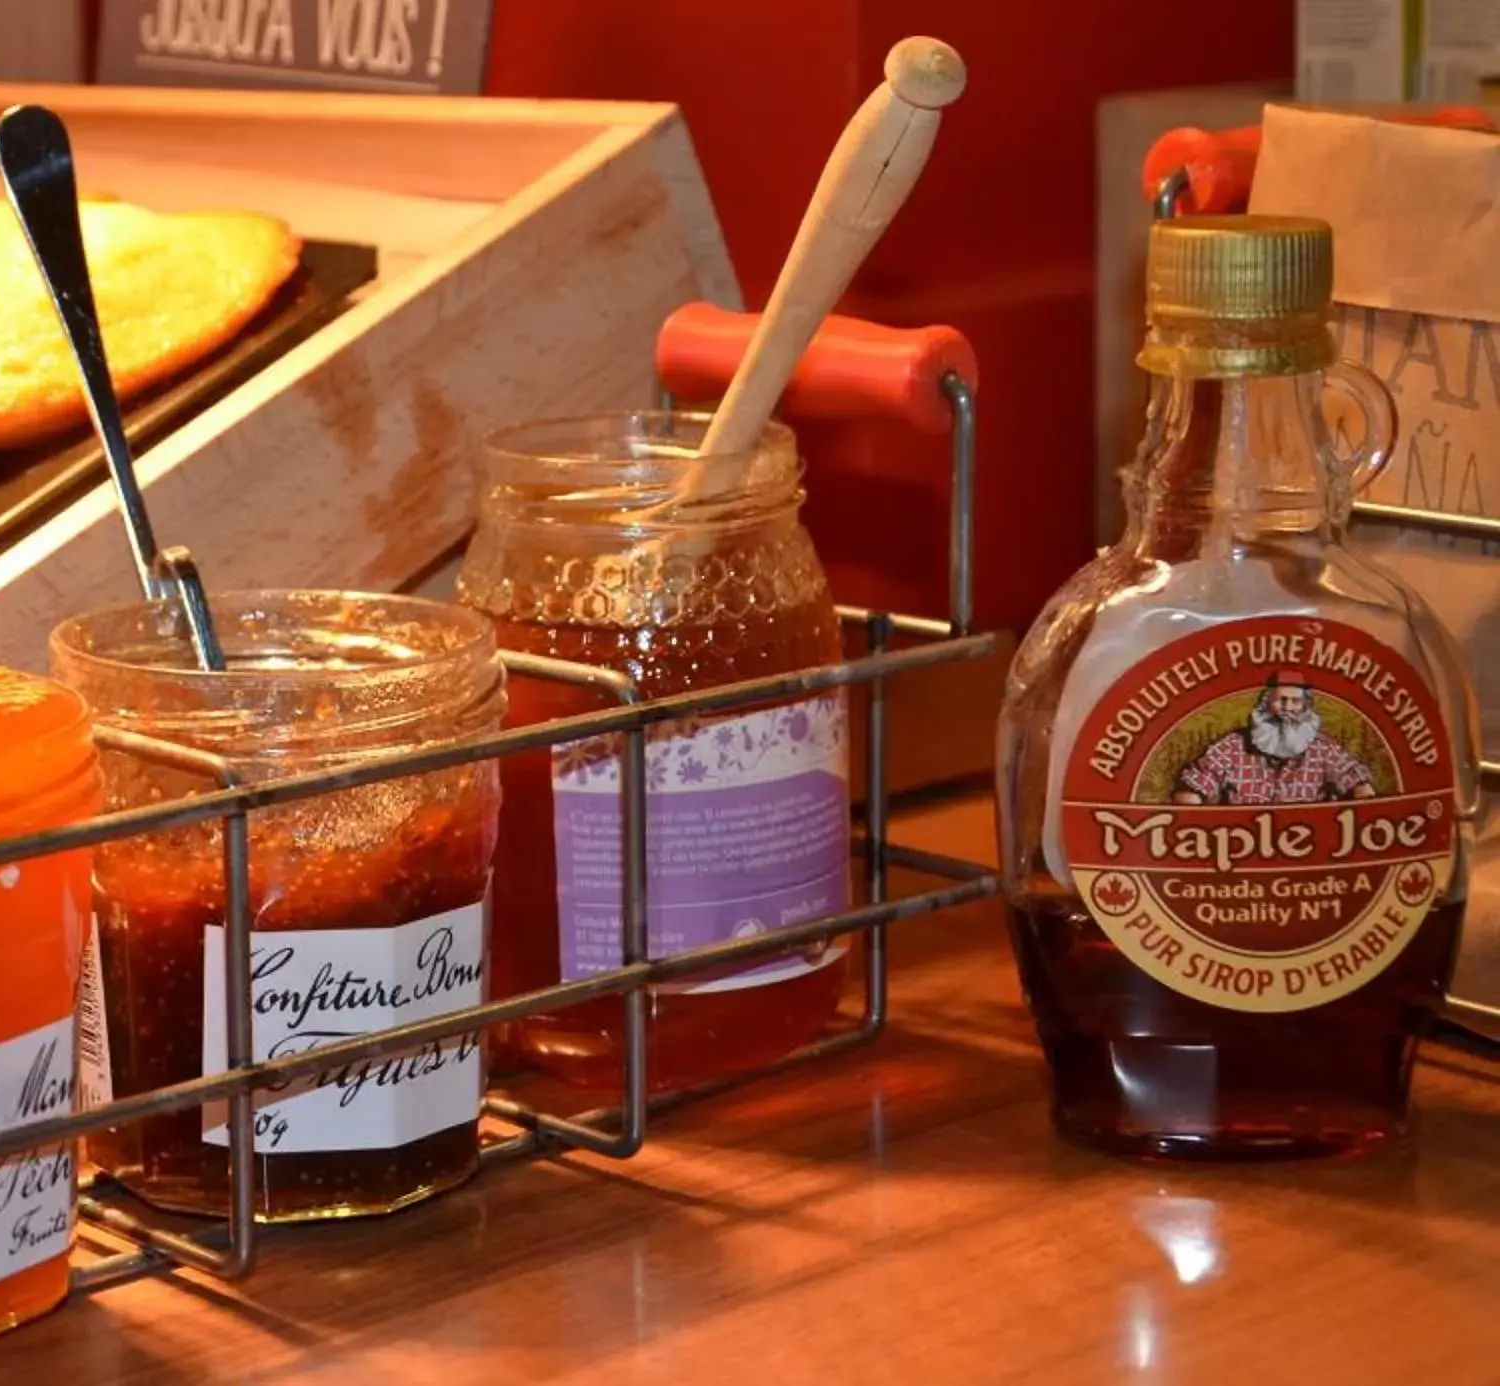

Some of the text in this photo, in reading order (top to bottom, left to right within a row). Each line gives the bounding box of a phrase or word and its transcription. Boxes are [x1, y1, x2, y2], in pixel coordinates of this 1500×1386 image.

[1089, 634, 1439, 779] ABSOLUTELY PURE MAPLE SYRUP
[1094, 808, 1315, 873] Maple
[1162, 872, 1373, 899] Canada Grade A
[1196, 902, 1294, 928] Quality
[1123, 906, 1411, 997] PUR SIROP D'ERABLE
